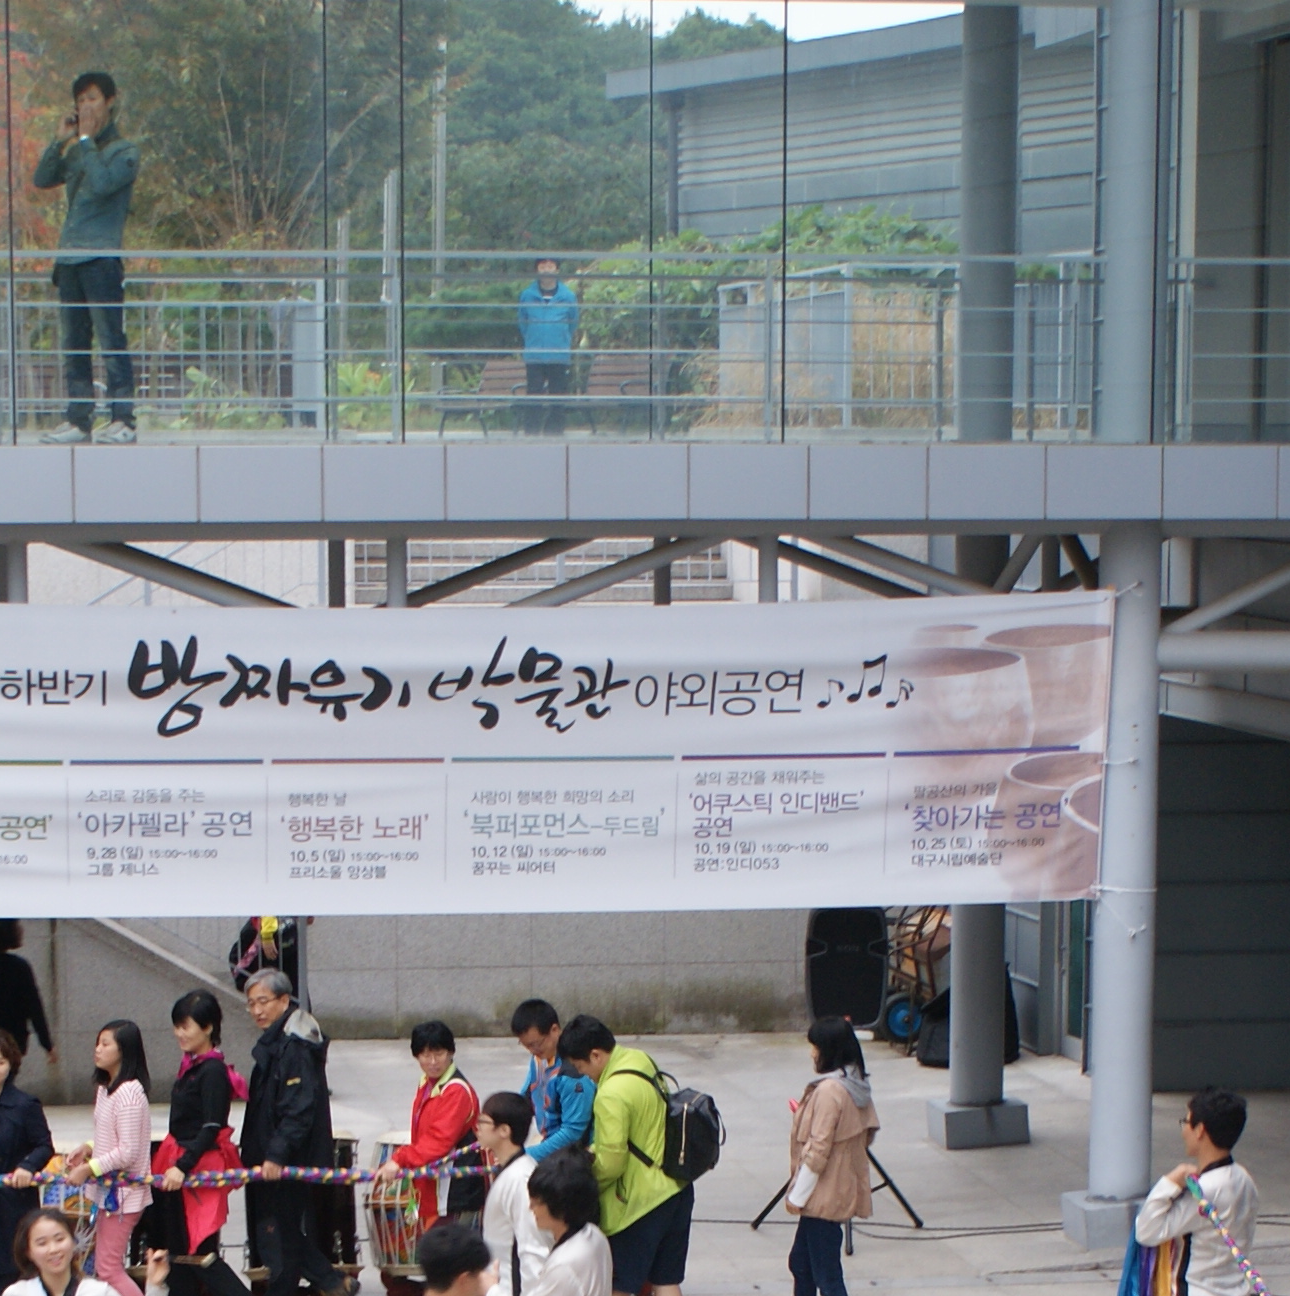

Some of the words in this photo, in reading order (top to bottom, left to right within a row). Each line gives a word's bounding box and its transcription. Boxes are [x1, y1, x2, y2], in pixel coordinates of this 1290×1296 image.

[0, 667, 107, 707] 하반기
[127, 635, 411, 738] 방짜유기
[427, 635, 629, 734] 박물관
[635, 667, 804, 717] 야외공연
[695, 771, 721, 786] 삶의
[726, 771, 766, 786] 공간을
[771, 769, 825, 785] 채워주는
[85, 788, 126, 804] 소리로
[132, 788, 173, 804] 감동을
[178, 788, 206, 804] 주는
[471, 790, 512, 805] 사람이
[517, 790, 557, 805] 행복한
[563, 789, 602, 805] 희망의
[607, 789, 635, 804] 소리
[913, 784, 966, 800] 팔공산의
[972, 782, 998, 797] 가을
[288, 792, 329, 808] 행복한
[334, 792, 347, 808] 날
[201, 811, 253, 838] 공연
[692, 816, 733, 839] 공연
[472, 861, 512, 876] 꿈꾸는
[516, 860, 556, 875] 씨어터
[693, 857, 781, 872] 공연:인디053
[911, 853, 1003, 868] 대구시립예술단
[87, 863, 114, 877] 그룹
[119, 862, 160, 877] 제니스
[347, 864, 387, 880] 앙상블
